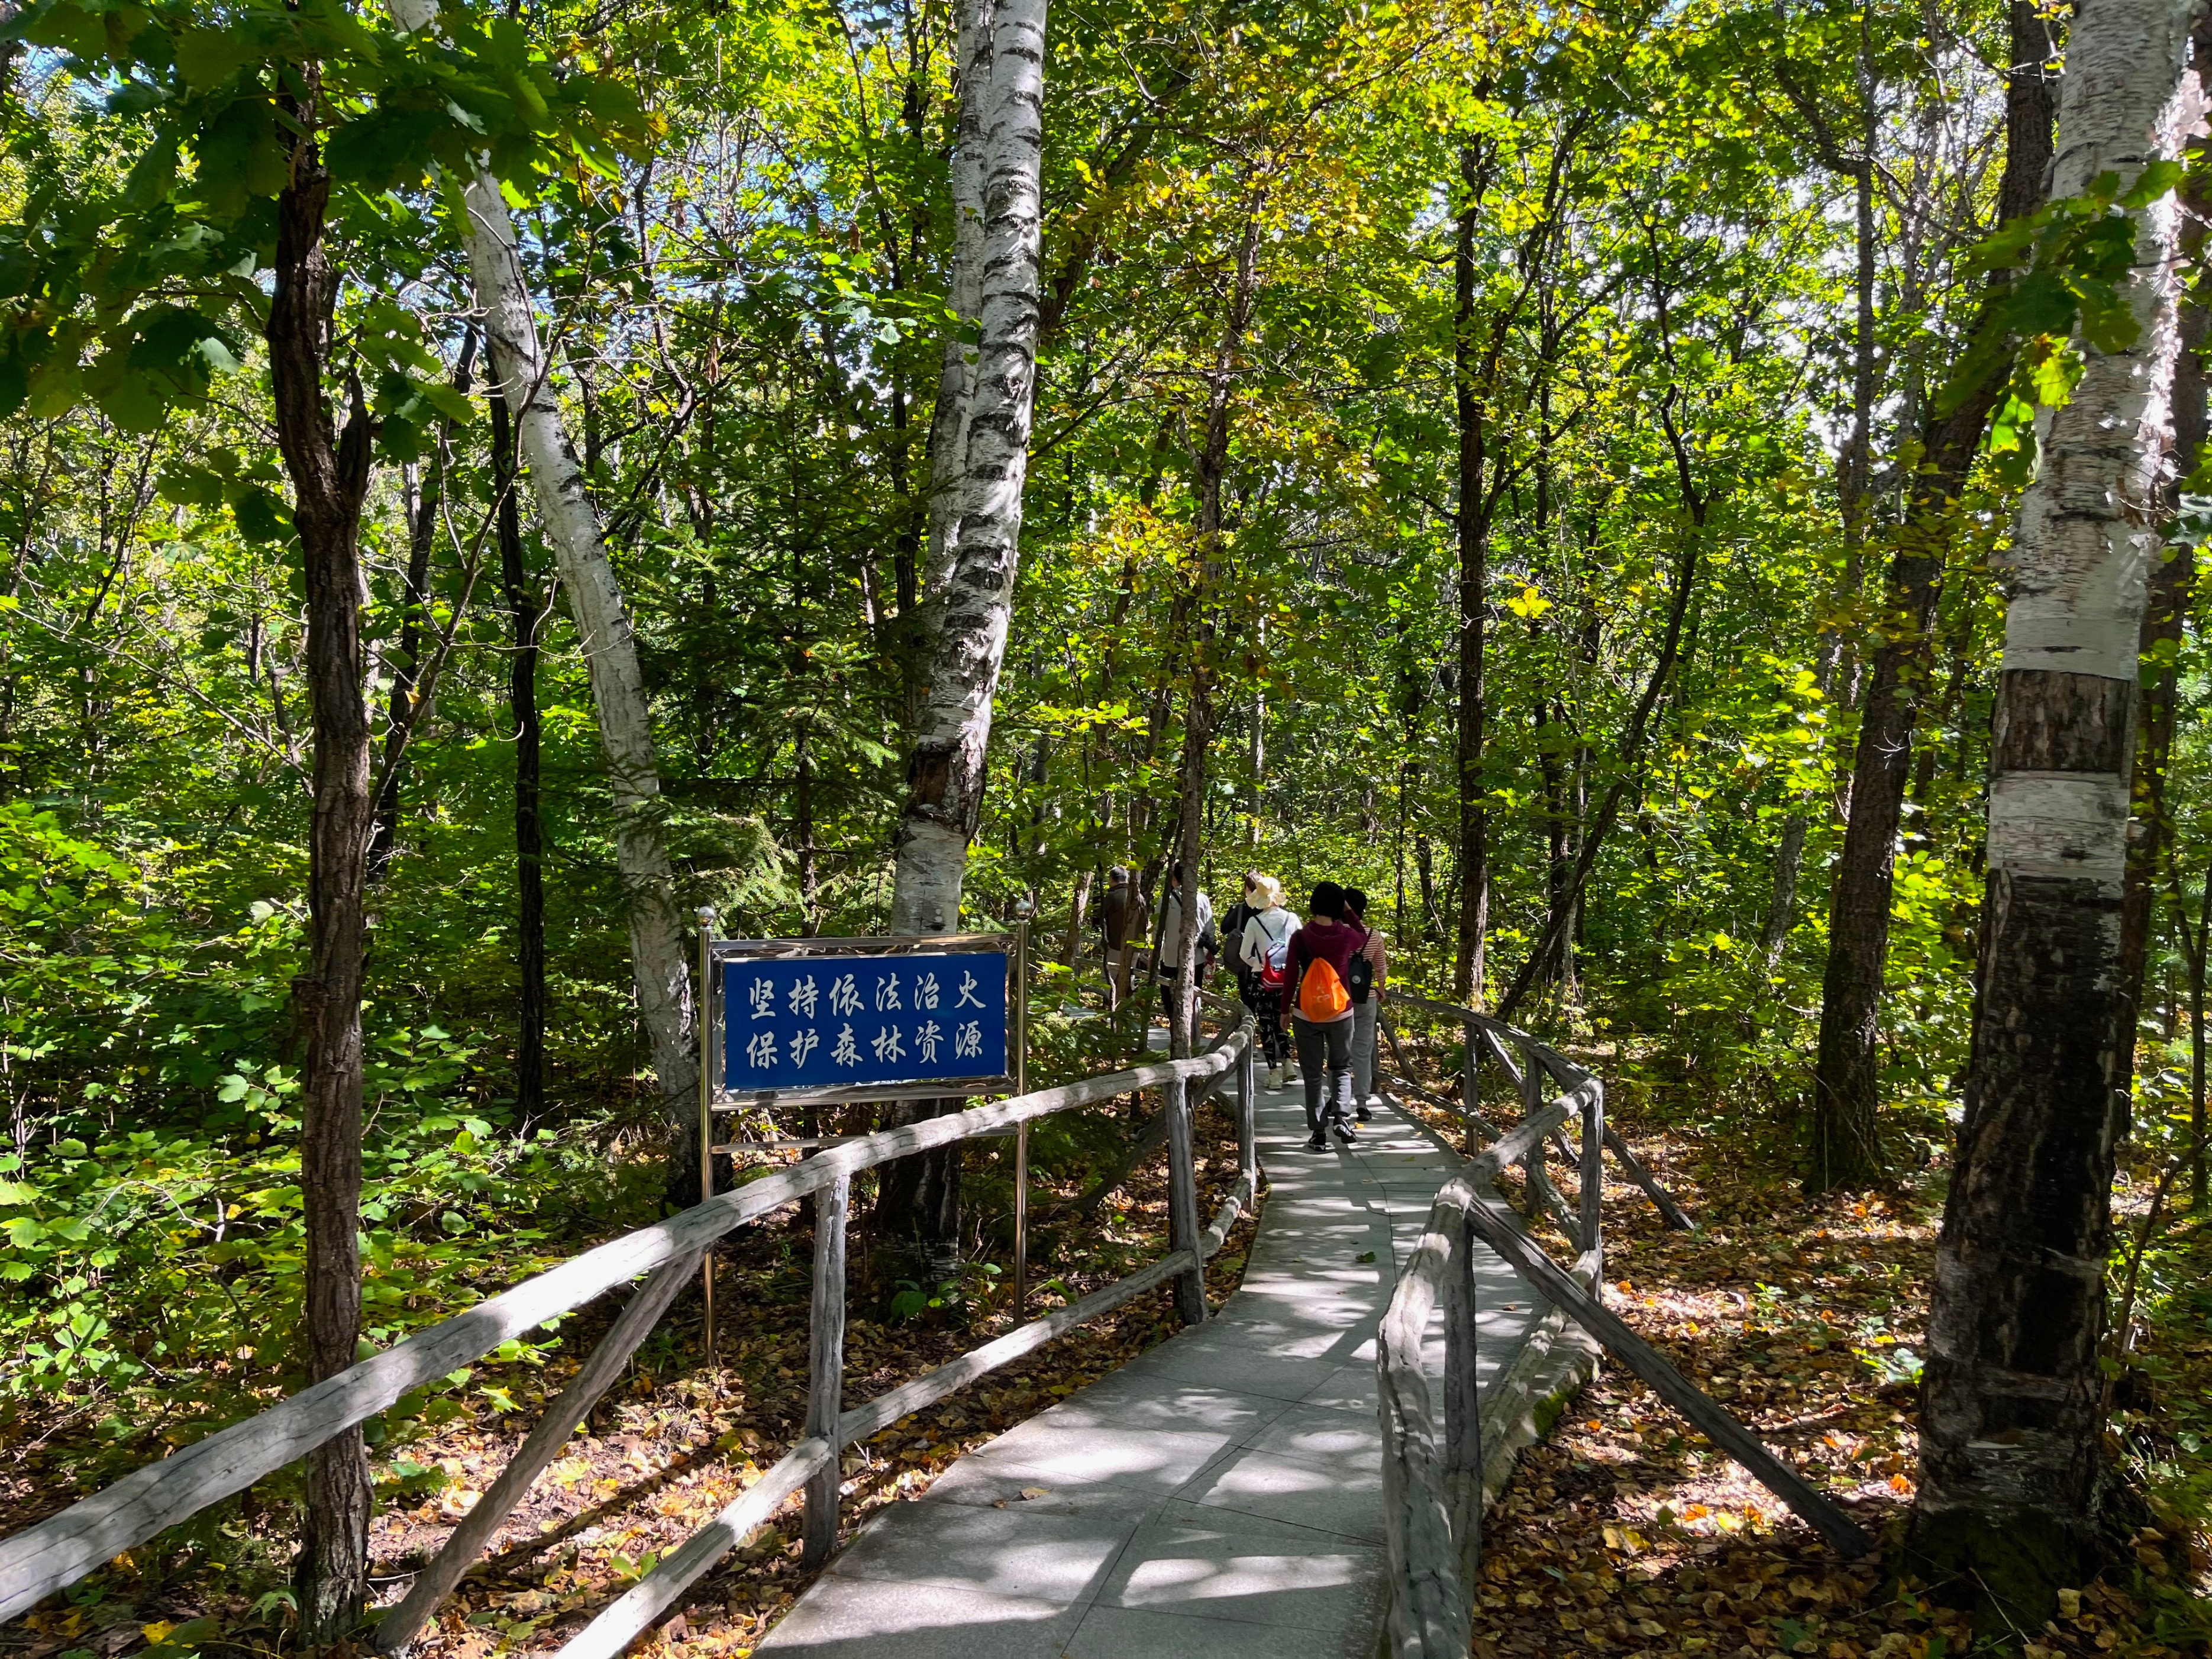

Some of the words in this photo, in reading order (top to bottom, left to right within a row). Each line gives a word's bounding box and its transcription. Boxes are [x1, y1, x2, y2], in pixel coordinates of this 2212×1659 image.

[749, 970, 987, 1020] 坚持依法治火
[746, 1020, 983, 1069] 保护森林资源
